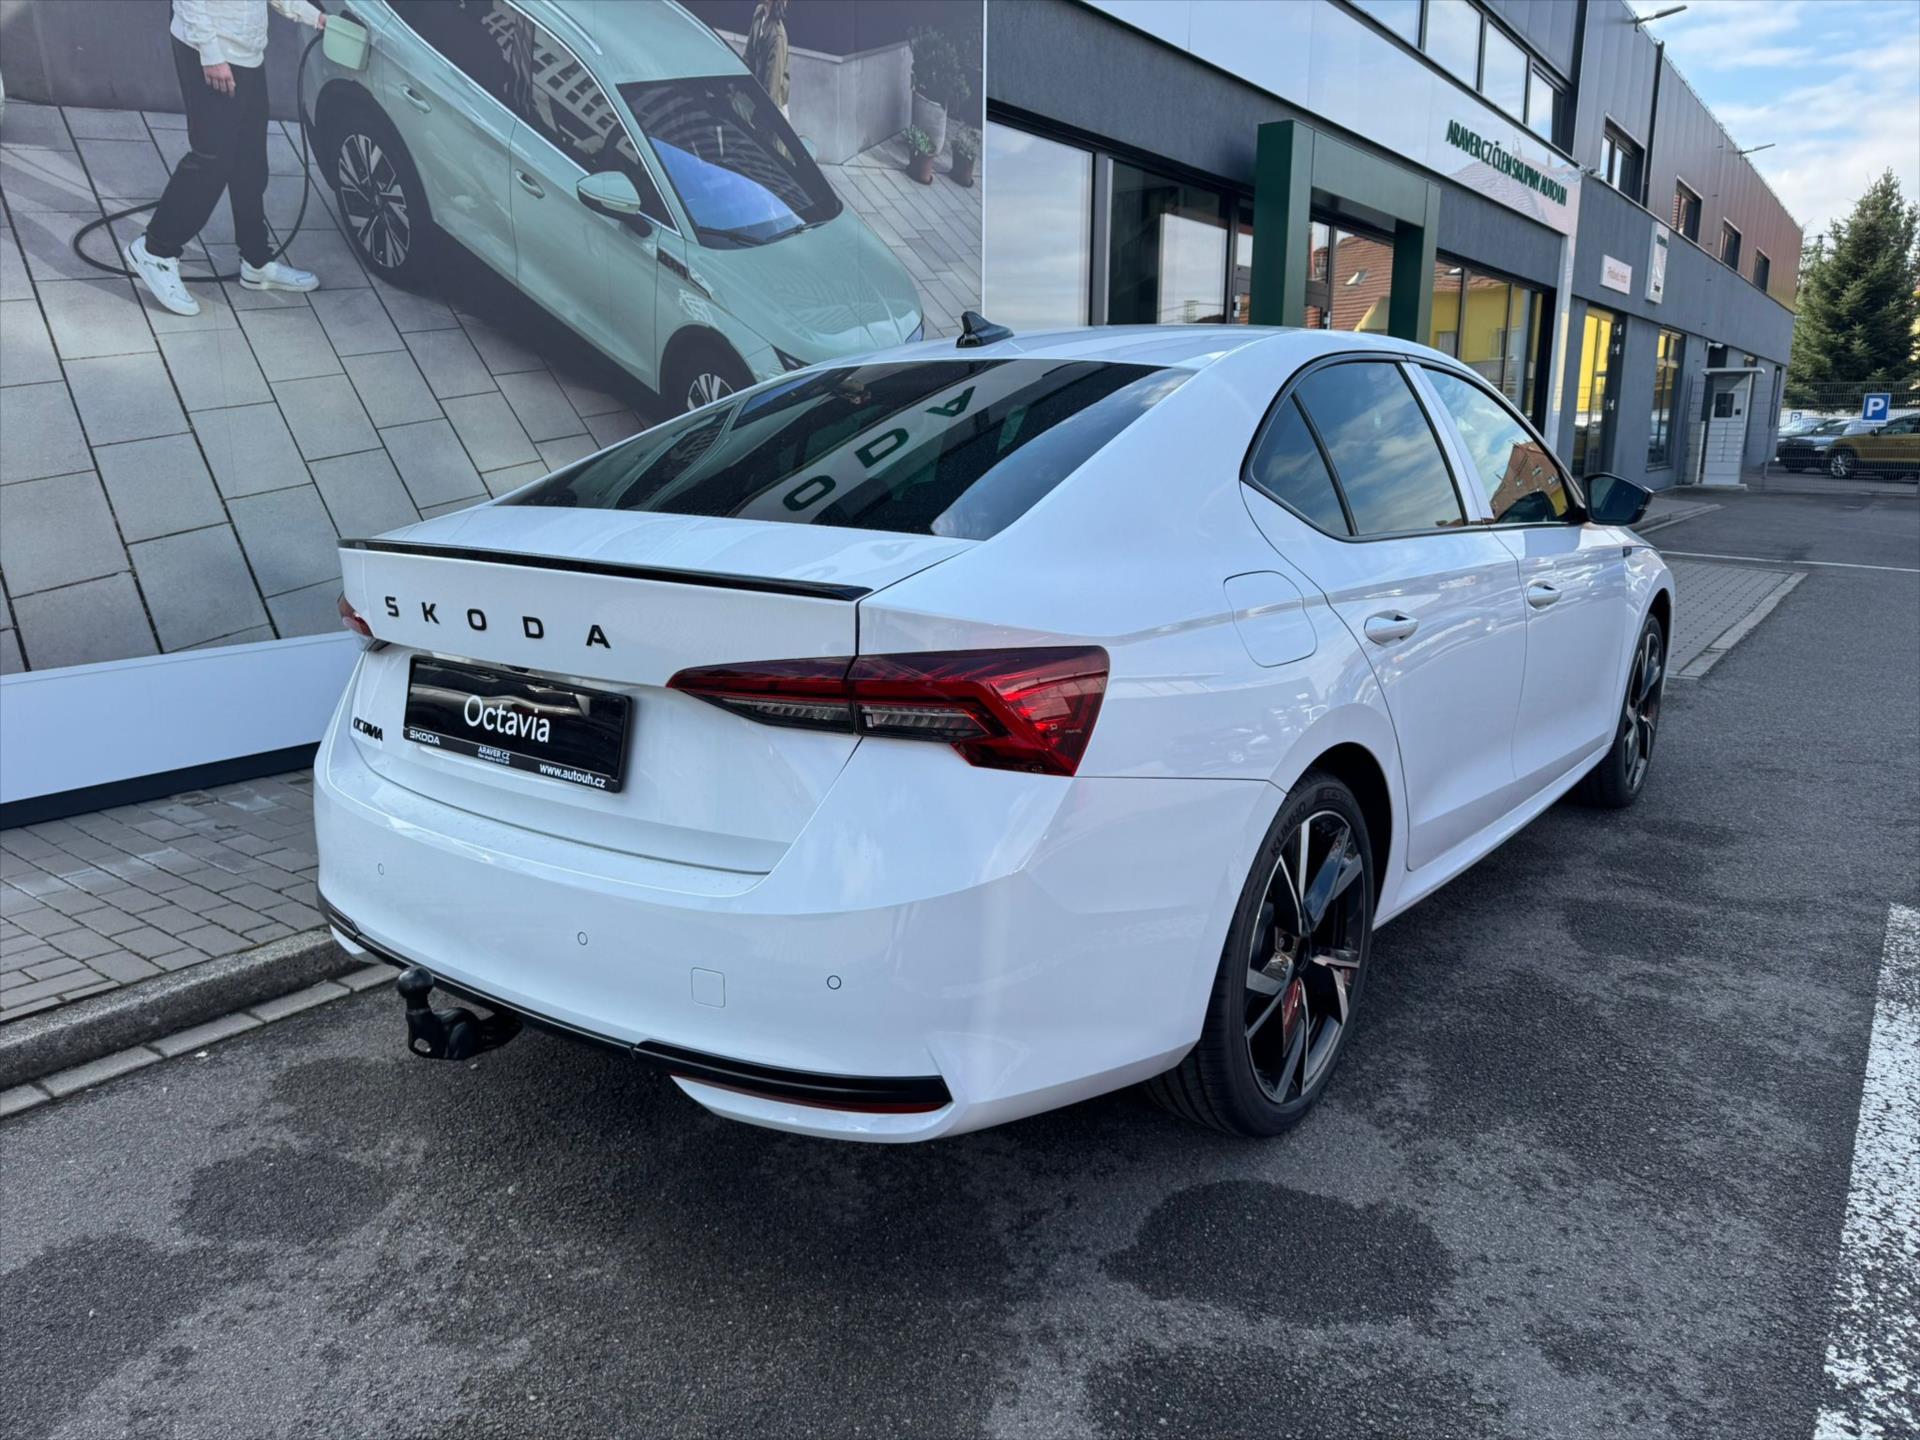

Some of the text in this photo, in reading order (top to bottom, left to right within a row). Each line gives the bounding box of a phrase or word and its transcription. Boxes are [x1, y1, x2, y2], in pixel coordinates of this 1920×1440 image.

[1445, 119, 1482, 160] ARAVER
[1481, 141, 1494, 165] CZ
[1866, 397, 1886, 418] P
[464, 694, 551, 743] Octavia
[539, 763, 606, 789] www.autouh.cz
